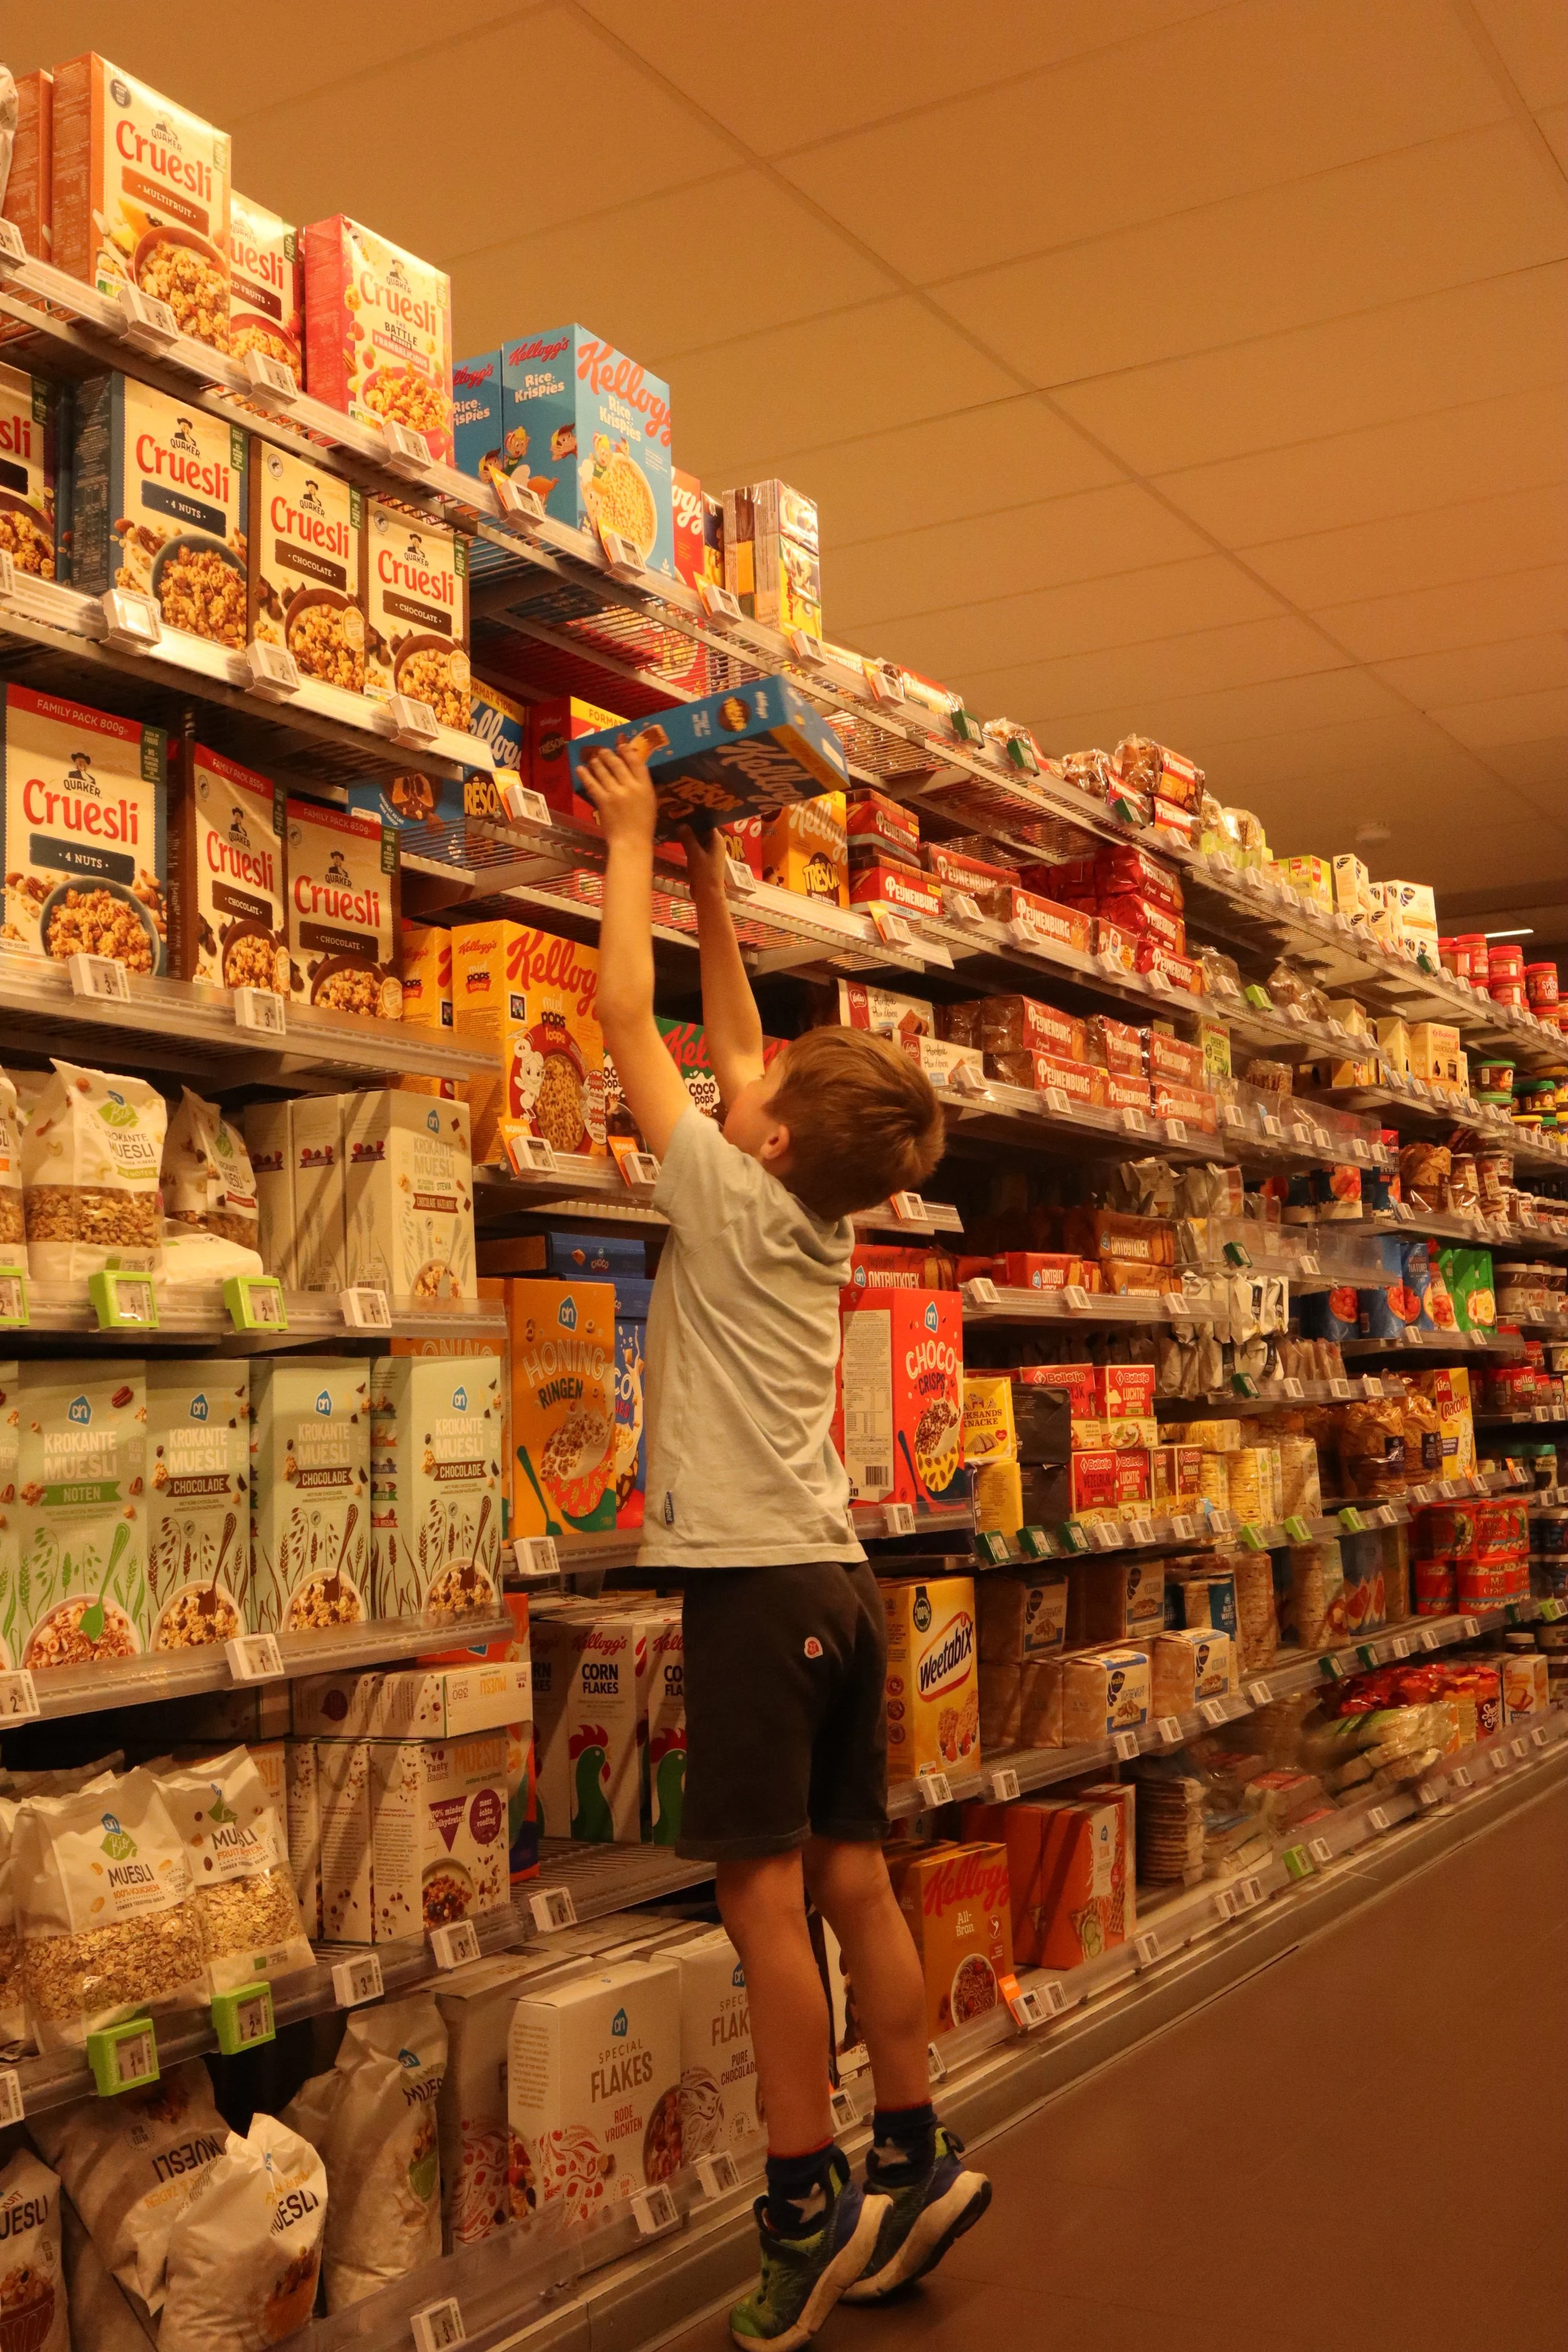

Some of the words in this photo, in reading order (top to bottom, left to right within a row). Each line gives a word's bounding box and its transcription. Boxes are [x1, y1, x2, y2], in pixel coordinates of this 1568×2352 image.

[151, 127, 183, 152] QUAKER
[116, 120, 212, 203] Cruesli
[142, 186, 192, 219] MULTIFRUIT
[241, 285, 267, 304] FRUITS
[386, 276, 411, 295] QUAKER
[360, 271, 436, 336] Cruesli
[384, 322, 417, 347] BATTLE
[396, 320, 406, 329] THE
[374, 336, 428, 368] FRAMBALICIOUS
[509, 336, 569, 366] Kellogg's
[524, 373, 550, 387] Rice
[514, 381, 564, 403] Krispies
[453, 399, 481, 413] Rice
[608, 395, 631, 418] Rice
[599, 406, 640, 442] Krispies
[170, 437, 201, 458] QUAKER
[136, 433, 229, 503] Cruesli
[171, 500, 176, 509] 4
[179, 502, 202, 519] NUTS
[299, 499, 325, 519] QUAKER
[271, 495, 349, 559] Cruesli
[292, 554, 332, 577] CHOCOLATE
[404, 551, 430, 568] QUAKER
[378, 549, 455, 605] Cruesli
[399, 603, 438, 624] CHOCOLATE
[36, 699, 70, 718] FAMILY
[72, 708, 97, 726] PACK
[213, 758, 232, 774] FAMILY
[233, 767, 248, 781] PACK
[64, 778, 103, 798] QUAKER
[23, 778, 139, 845] Cruesli
[304, 808, 326, 822] FAMILY
[328, 815, 348, 828] PACK
[229, 831, 251, 849] QUAKER
[65, 850, 72, 863] 4
[74, 854, 103, 869] NUTS
[206, 830, 274, 892] Cruesli
[325, 873, 352, 889] QUAKER
[803, 857, 840, 893] TRÉSOR
[228, 896, 260, 916] CHOCOLATE
[294, 874, 380, 928] Cruesli
[320, 934, 360, 950] CHOCOLATE
[458, 940, 497, 955] Kellogg's
[467, 971, 490, 983] pops
[541, 1010, 566, 1029] pops
[545, 1027, 566, 1044] loops
[688, 1083, 716, 1096] COCO
[694, 1094, 714, 1106] pops
[504, 1123, 529, 1135] BONUS
[109, 1141, 155, 1159] MUESLI
[413, 1136, 454, 1158] KROKANTE
[615, 1142, 636, 1151] BONUS
[413, 1153, 455, 1179] MUESLI
[437, 1182, 452, 1191] STEVIA
[522, 1338, 606, 1389] HONING
[905, 1340, 955, 1378] CHOCO
[918, 1372, 946, 1395] CRISPS
[1047, 1370, 1086, 1384] Bolletje
[1125, 1372, 1150, 1383] Bolletje
[538, 1377, 584, 1410] RINGEN
[1123, 1387, 1145, 1401] LUCHTIG
[298, 1422, 349, 1443] KROKANTE
[435, 1417, 484, 1436] KROKANTE
[43, 1431, 117, 1453] KROKANTE
[169, 1427, 228, 1449] KROKANTE
[435, 1436, 484, 1459] MUESLI
[169, 1448, 228, 1474] MUESLI
[298, 1442, 350, 1466] MUESLI
[1088, 1457, 1112, 1470] Bolletje
[1120, 1456, 1144, 1467] Bolletje
[43, 1454, 117, 1480] MUESLI
[439, 1465, 482, 1479] CHOCOLADE
[174, 1478, 225, 1495] CHOCOLADE
[302, 1471, 347, 1487] CHOCOLADE
[1120, 1470, 1140, 1485] LUCHTIG
[63, 1486, 101, 1503] NOTEN
[572, 1631, 627, 1655] Kellogg's
[919, 1619, 973, 1692] Weetabix
[582, 1663, 619, 1681] CORN
[452, 1688, 469, 1700] 350
[480, 1675, 507, 1695] MUESLI
[582, 1682, 618, 1695] FLAKES
[453, 1738, 504, 1777] MUESLI
[426, 1761, 449, 1775] Tasty
[426, 1772, 450, 1783] Basics
[445, 1804, 465, 1816] minder
[479, 1798, 492, 1808] meer
[479, 1807, 493, 1817] échte
[429, 1814, 466, 1830] koolhydraten
[477, 1816, 496, 1828] voeding
[217, 1848, 240, 1861] FRUIT
[107, 1863, 156, 1888] MUESLI
[956, 1910, 972, 1926] All-
[955, 1921, 974, 1938] Bran
[598, 2038, 644, 2064] SPECIAL
[731, 2049, 748, 2066] PURE
[590, 2051, 653, 2103] FLAKES
[614, 2105, 633, 2124] RODE
[605, 2117, 643, 2143] VRUCHTEN
[152, 2135, 227, 2183] MUESLI
